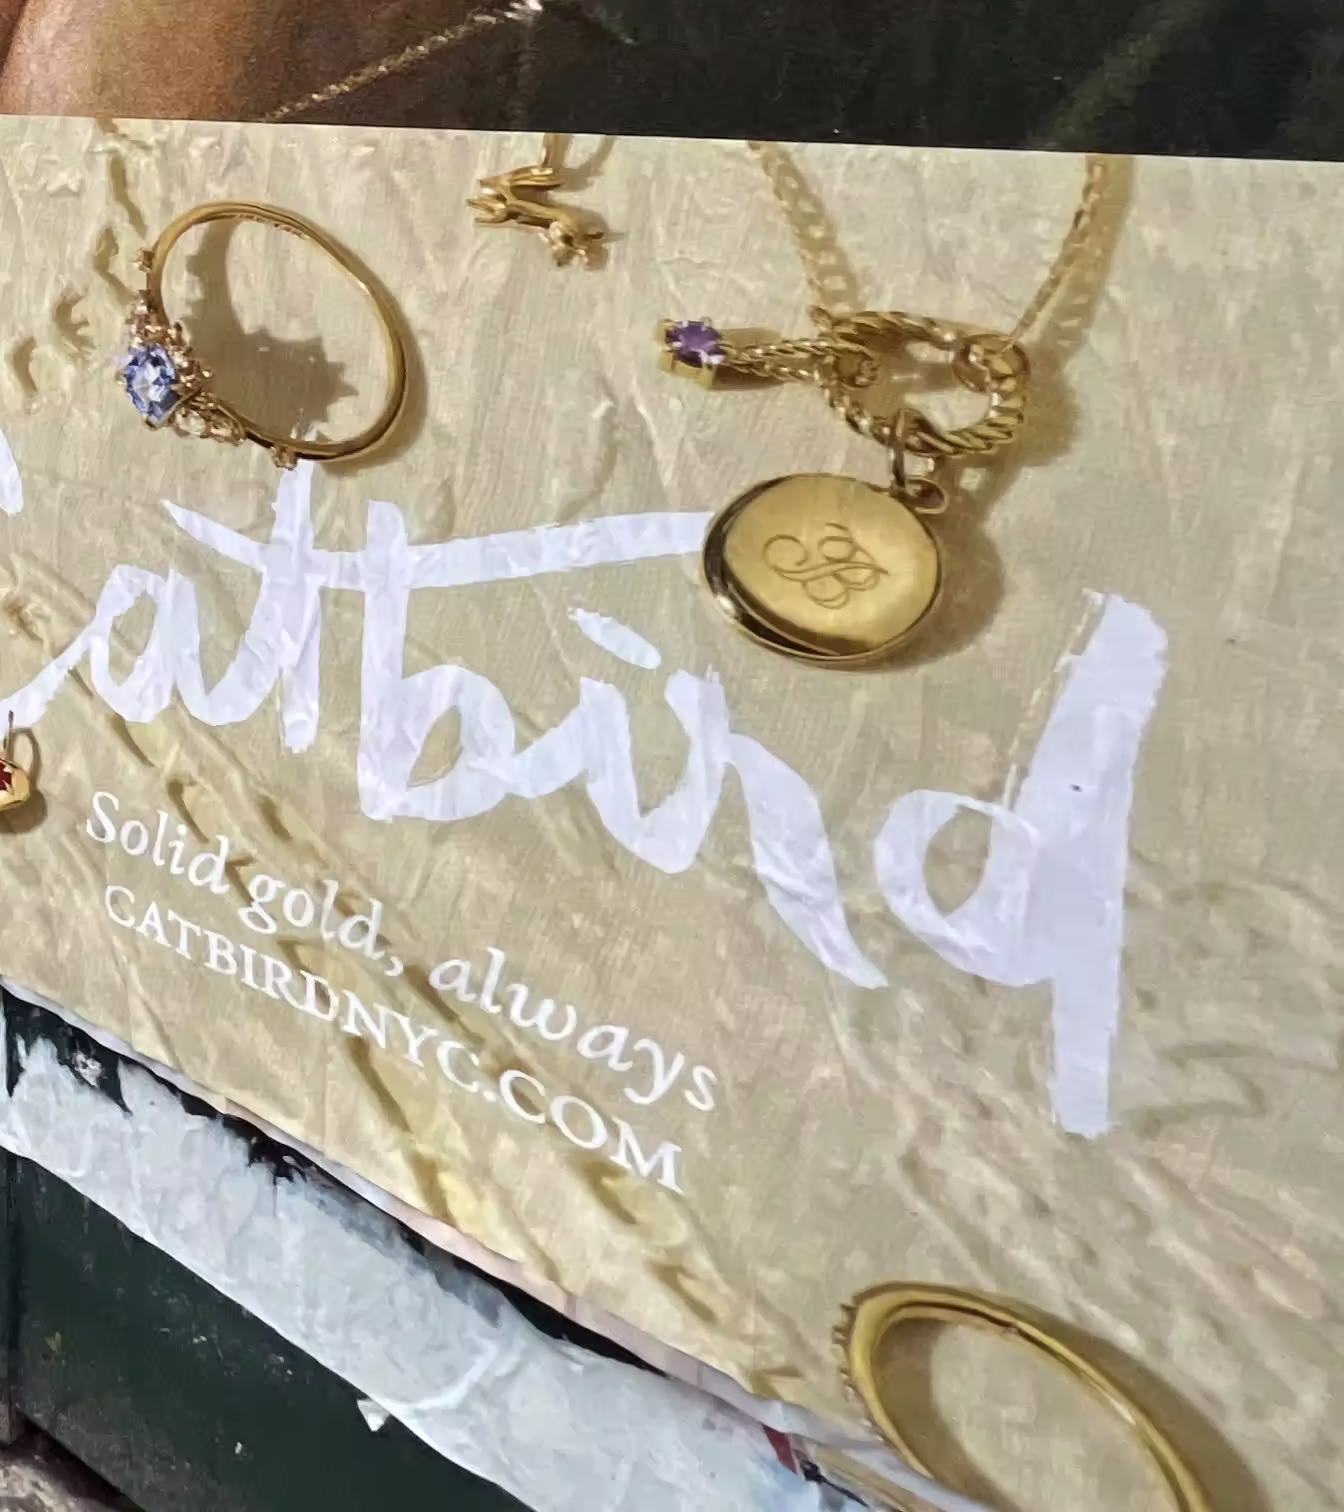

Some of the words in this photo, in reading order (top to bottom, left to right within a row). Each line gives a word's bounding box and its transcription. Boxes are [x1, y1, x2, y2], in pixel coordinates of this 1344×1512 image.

[85, 791, 230, 896] Solid
[238, 880, 404, 978] gold,
[428, 946, 718, 1112] always
[105, 885, 683, 1193] CATBIRDNYC.COM
